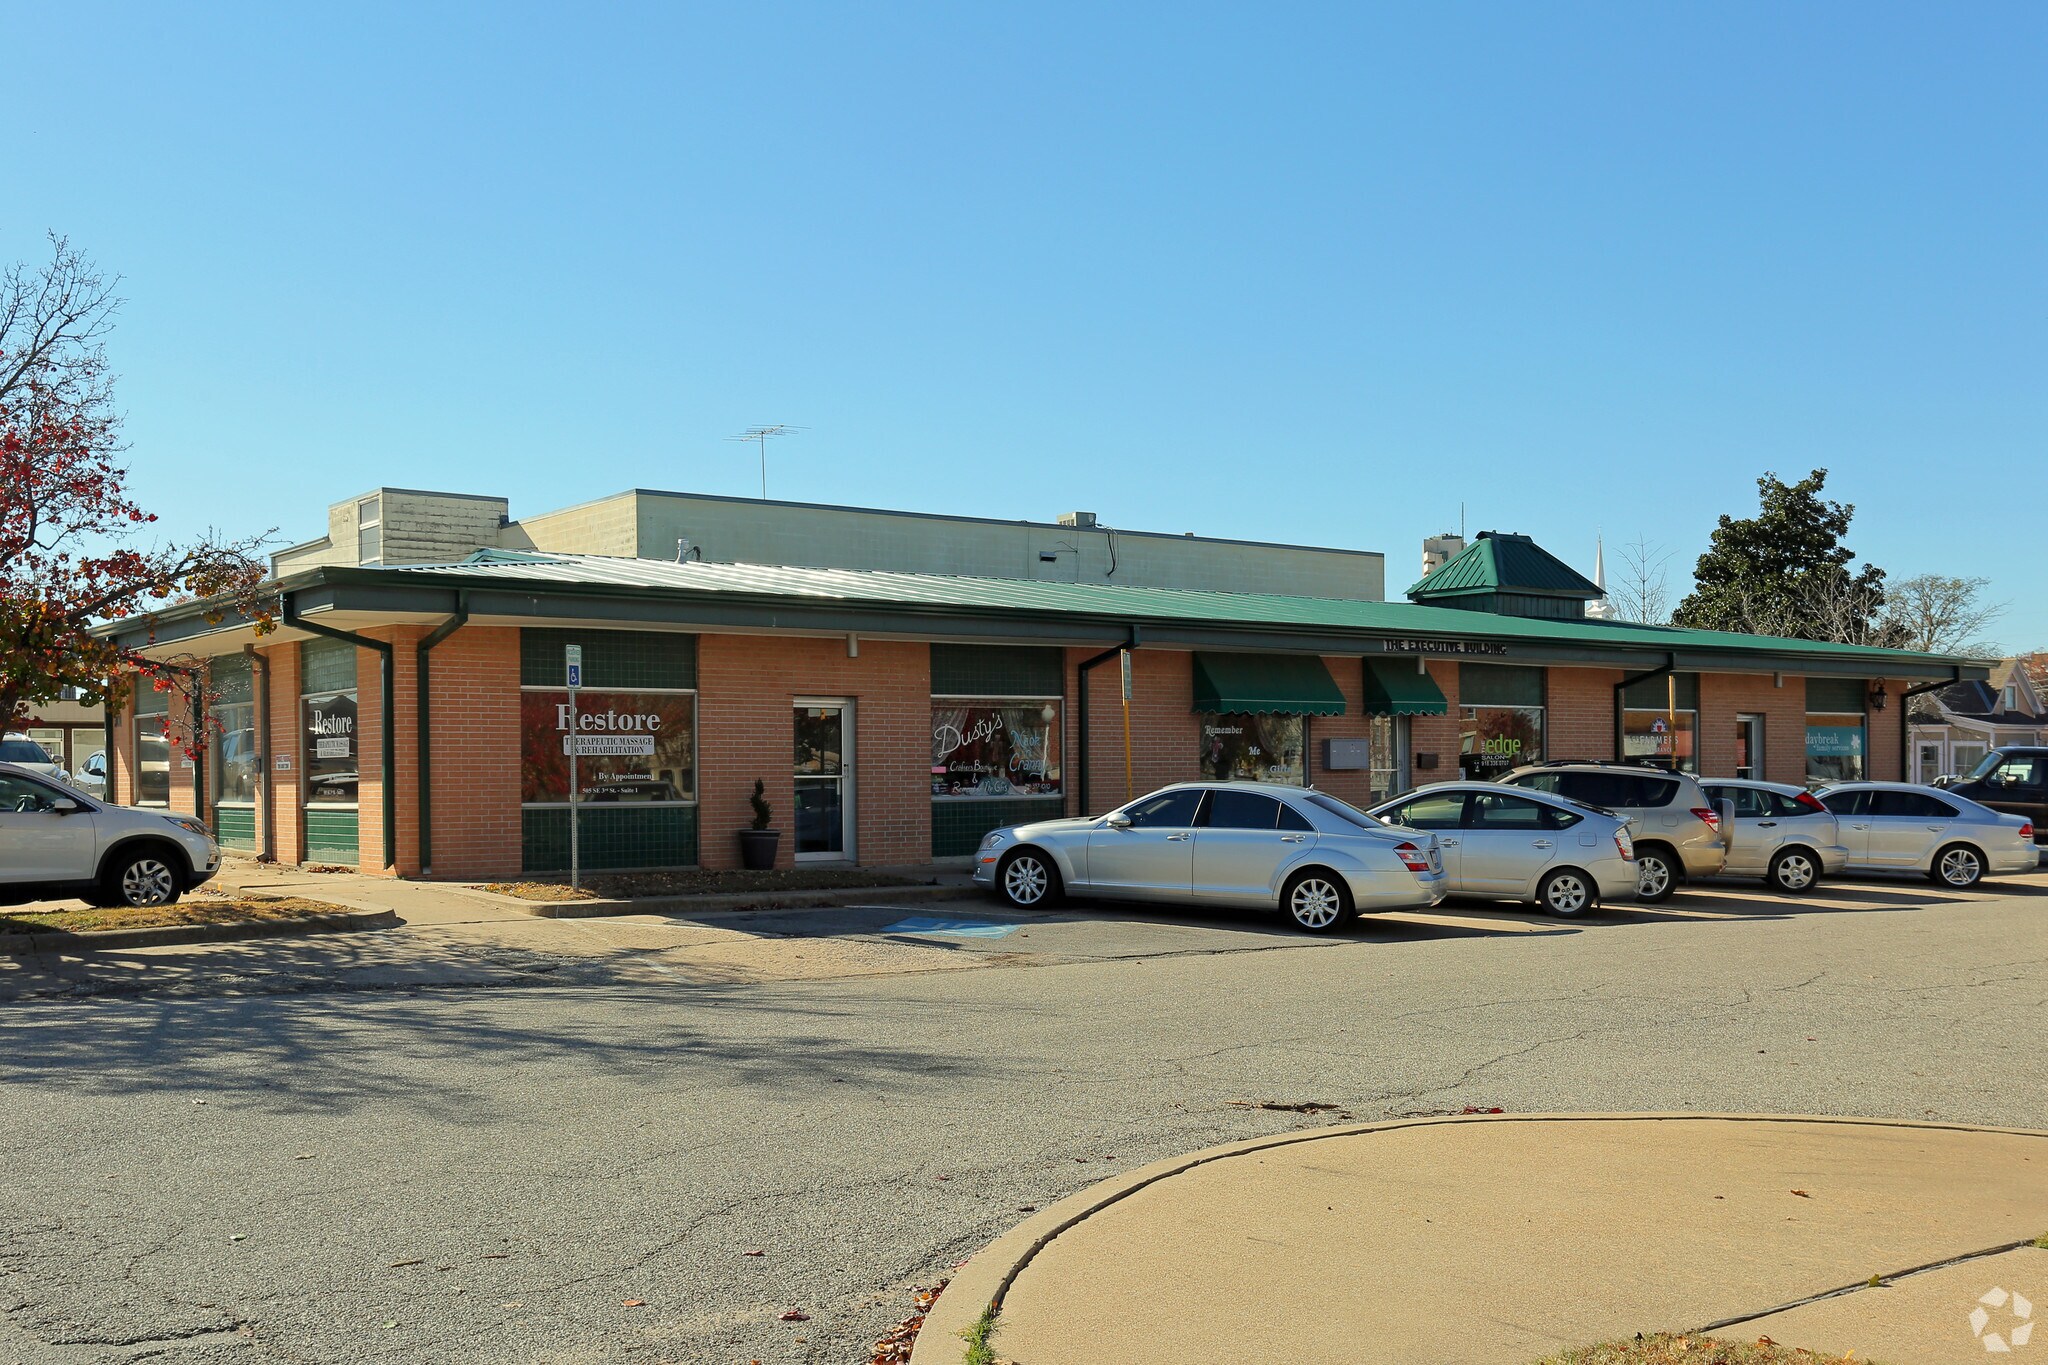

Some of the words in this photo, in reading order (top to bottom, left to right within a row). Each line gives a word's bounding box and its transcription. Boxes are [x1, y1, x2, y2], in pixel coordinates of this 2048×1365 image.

[1384, 640, 1405, 651] THE
[1409, 640, 1461, 653] EXECUTIVE
[314, 709, 353, 735] Restore
[555, 703, 661, 731] Restore
[934, 712, 1003, 758] Dusty's
[1204, 725, 1243, 737] Remember
[565, 737, 617, 746] TERAPEUTIC
[618, 737, 653, 746] MASSAGE
[1485, 733, 1521, 758] edge
[1805, 732, 1839, 746] daybreak
[581, 746, 645, 754] REHABILITATION
[1248, 746, 1261, 756] Me
[598, 772, 609, 782] By
[609, 772, 655, 782] Appointment
